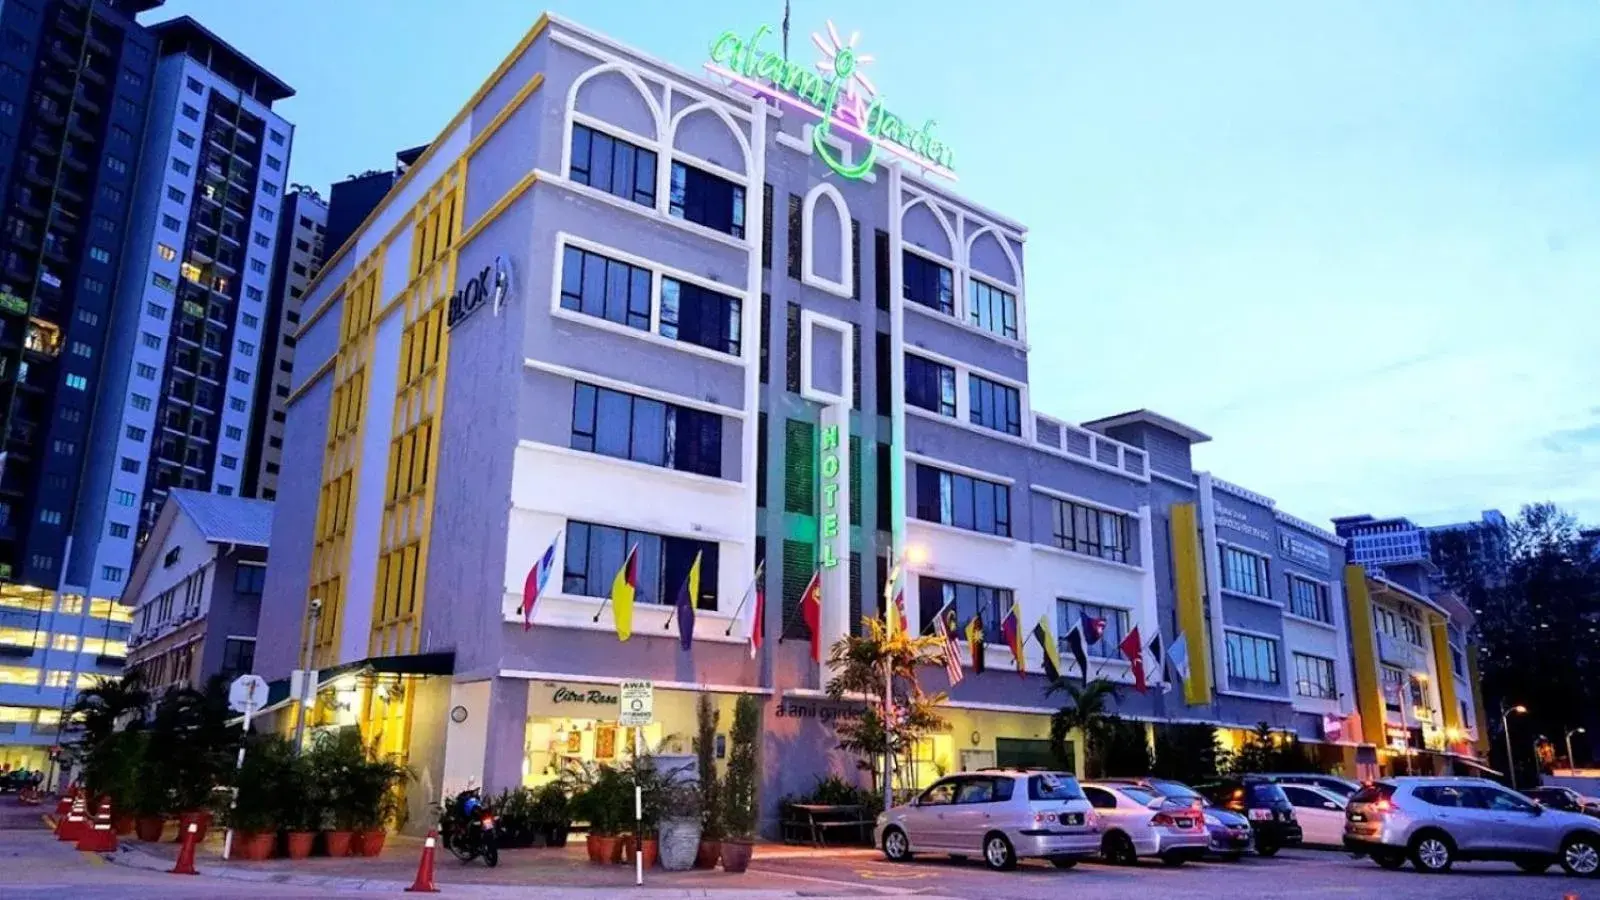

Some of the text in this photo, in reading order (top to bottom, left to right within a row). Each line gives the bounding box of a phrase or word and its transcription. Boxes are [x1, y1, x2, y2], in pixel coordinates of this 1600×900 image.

[447, 265, 491, 327] BLOK
[823, 424, 840, 568] HOTEL
[553, 687, 584, 704] Citra
[623, 682, 651, 690] AWAS
